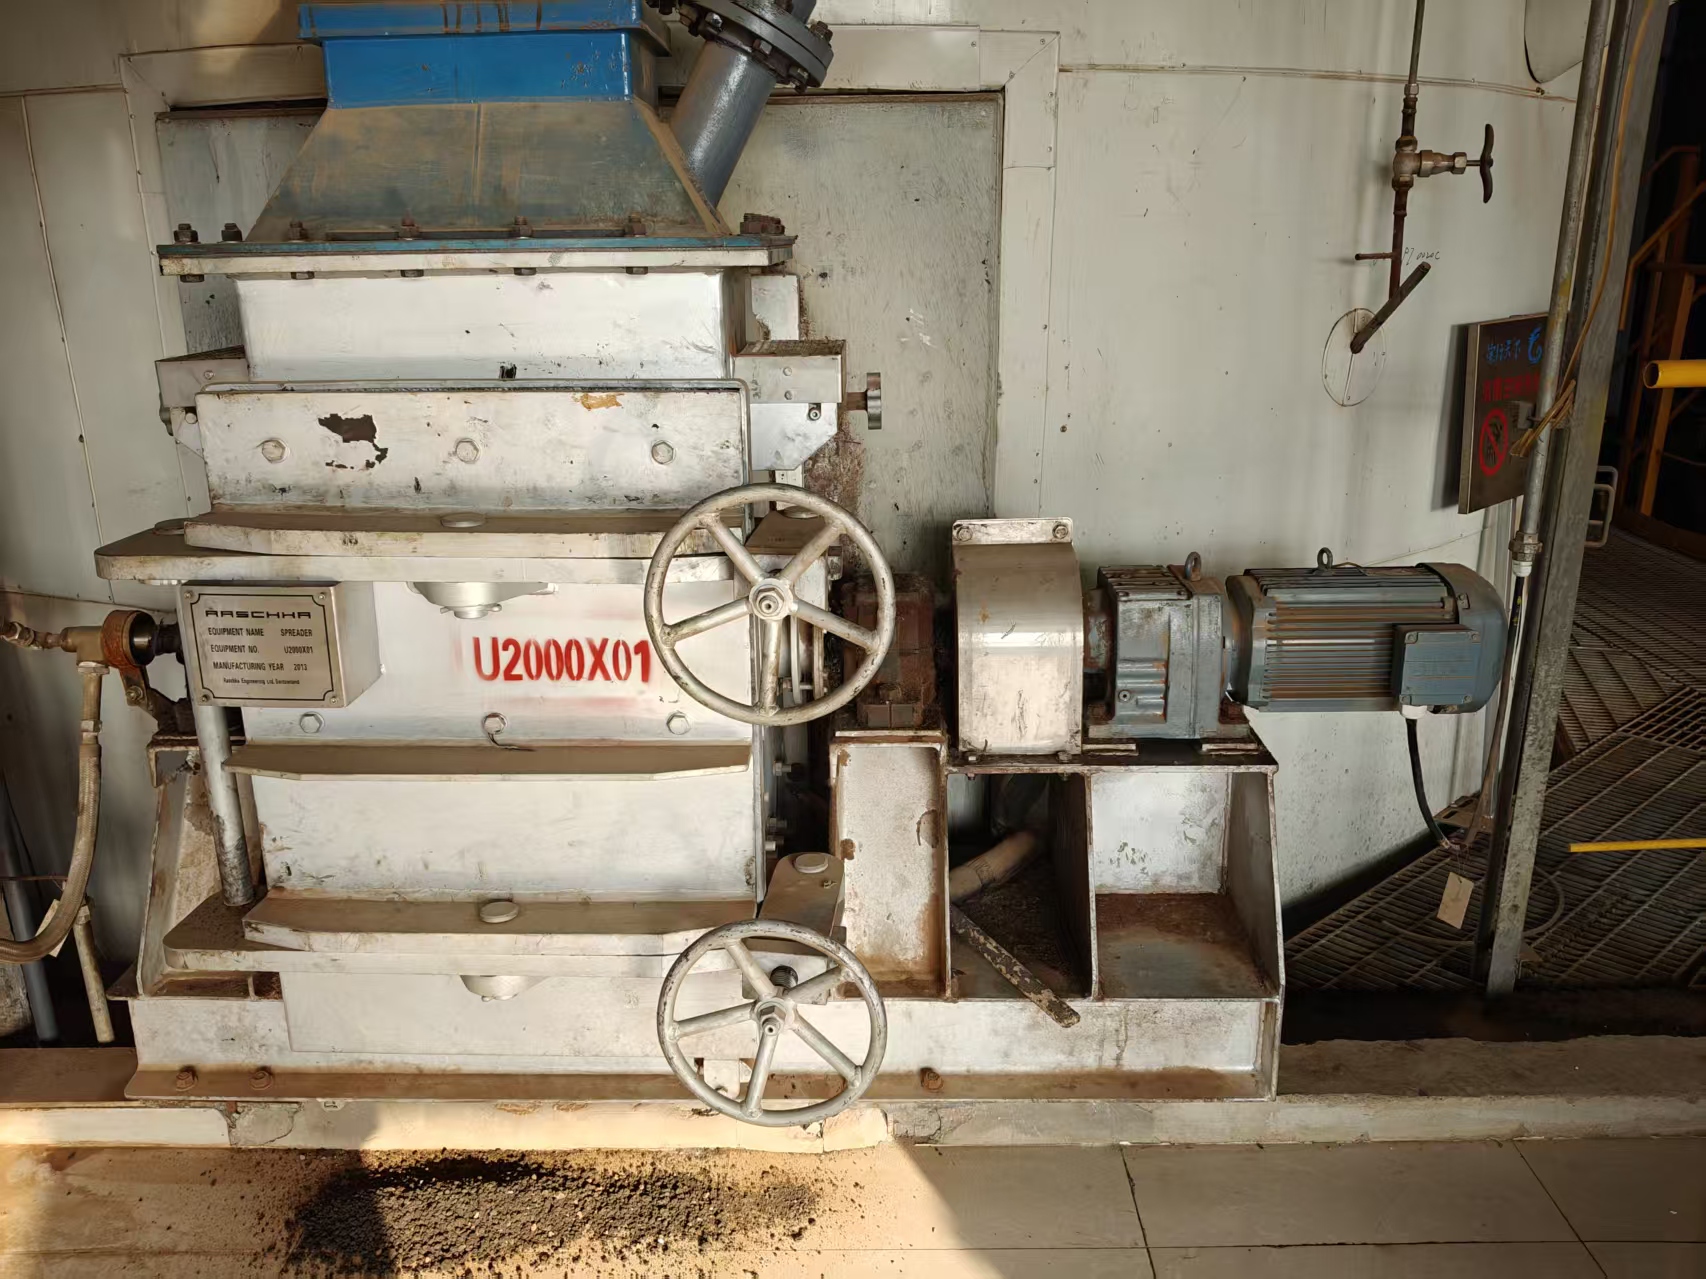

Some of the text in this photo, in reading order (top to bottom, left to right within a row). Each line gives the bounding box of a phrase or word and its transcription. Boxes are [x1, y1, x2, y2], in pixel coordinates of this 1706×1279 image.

[208, 627, 313, 637] EQUIPMENT NAME SPREADER
[210, 644, 313, 654] EQUIPMENT NO. U2000X01
[473, 636, 650, 683] U2000X01
[213, 661, 308, 671] MANUFACTURING YEAR 2013
